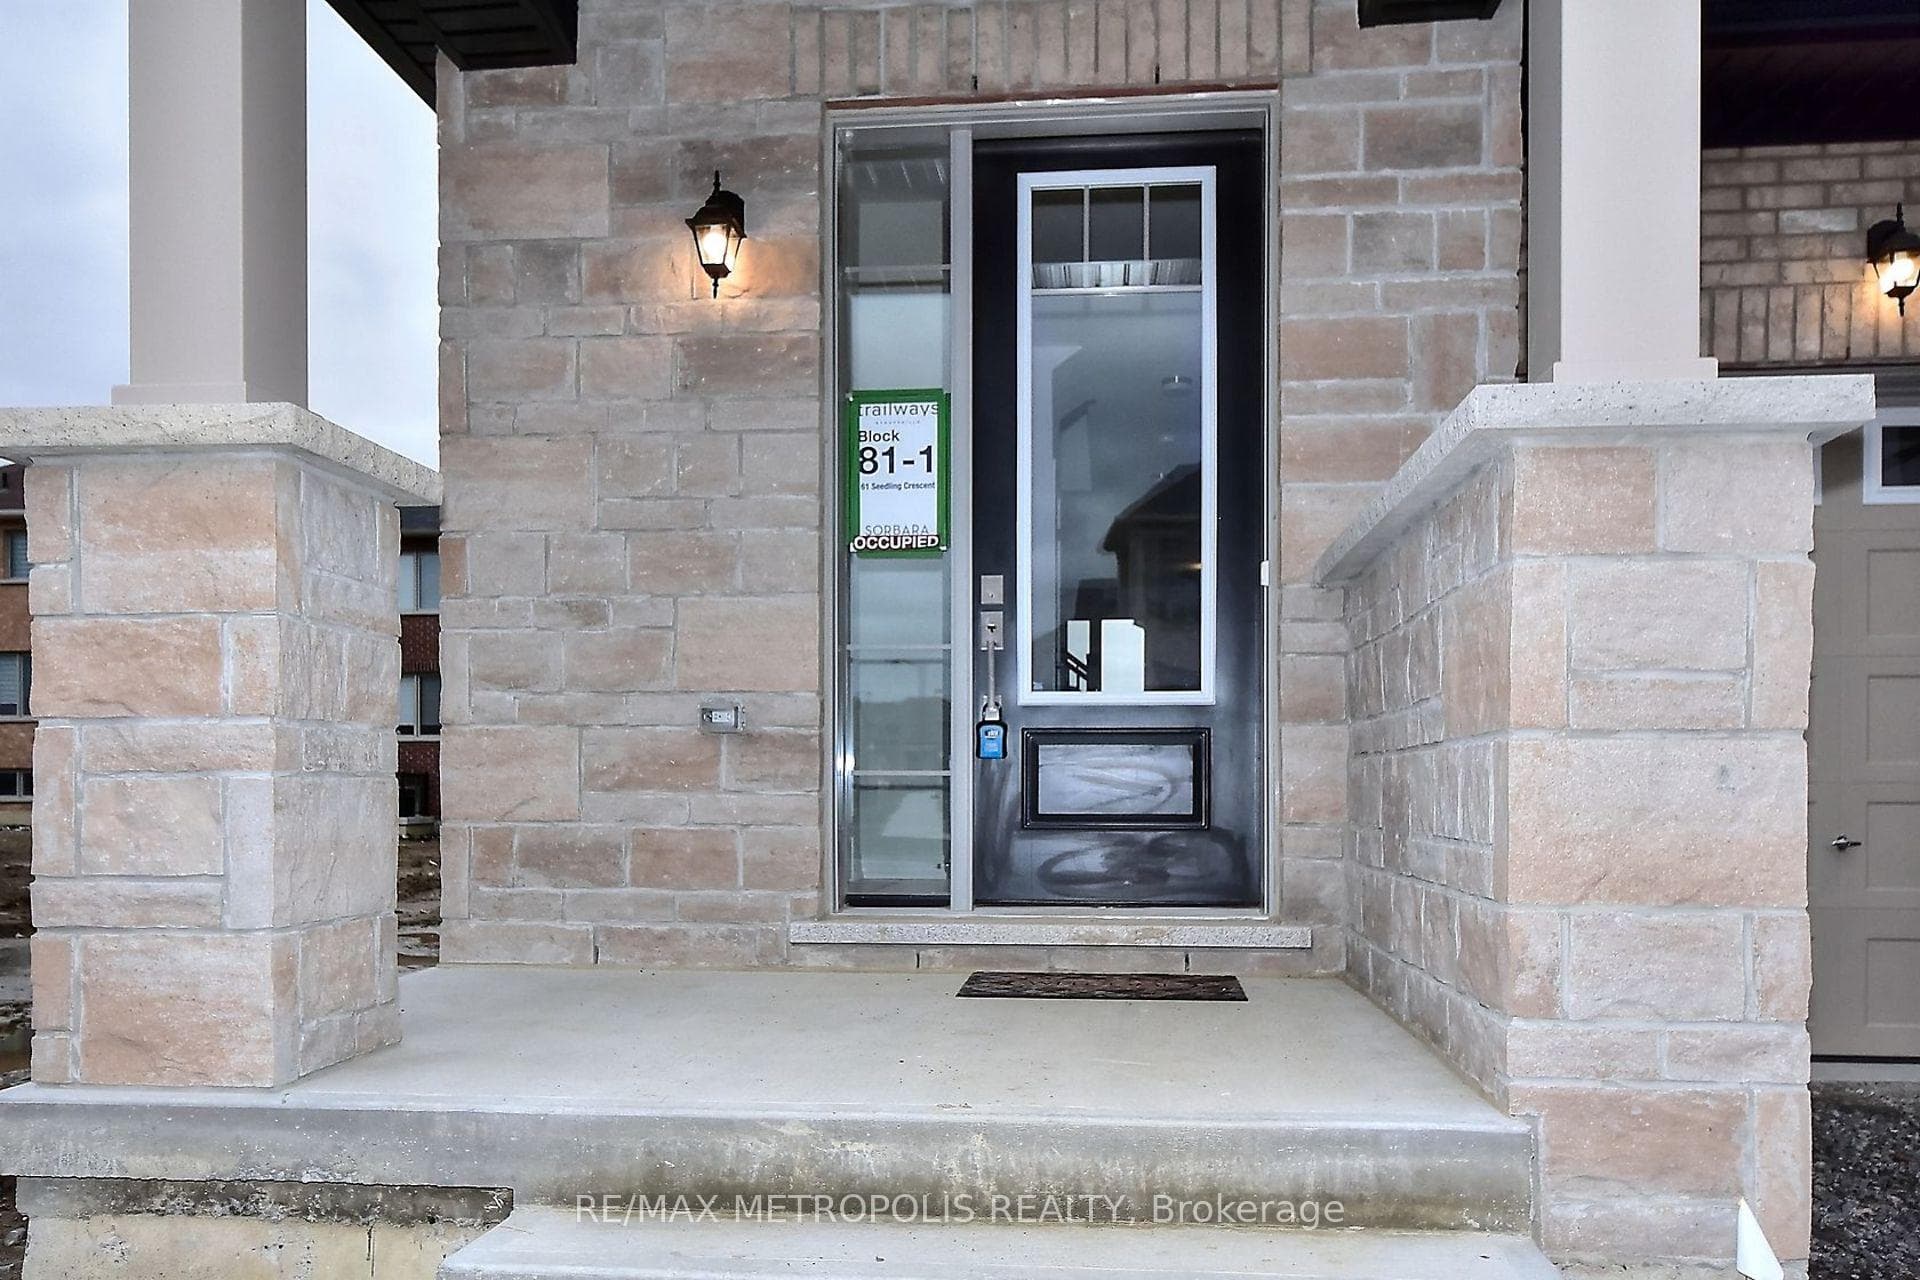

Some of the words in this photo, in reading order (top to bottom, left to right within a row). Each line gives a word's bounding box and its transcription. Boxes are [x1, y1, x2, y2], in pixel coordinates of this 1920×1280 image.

[859, 403, 938, 417] trailways
[859, 430, 900, 442] Block
[859, 445, 932, 474] 81-1
[861, 483, 869, 491] 61
[871, 482, 902, 491] Seedling
[903, 482, 935, 490] Crescent
[865, 525, 929, 535] SORBARA
[854, 536, 939, 550] OCCUPIED
